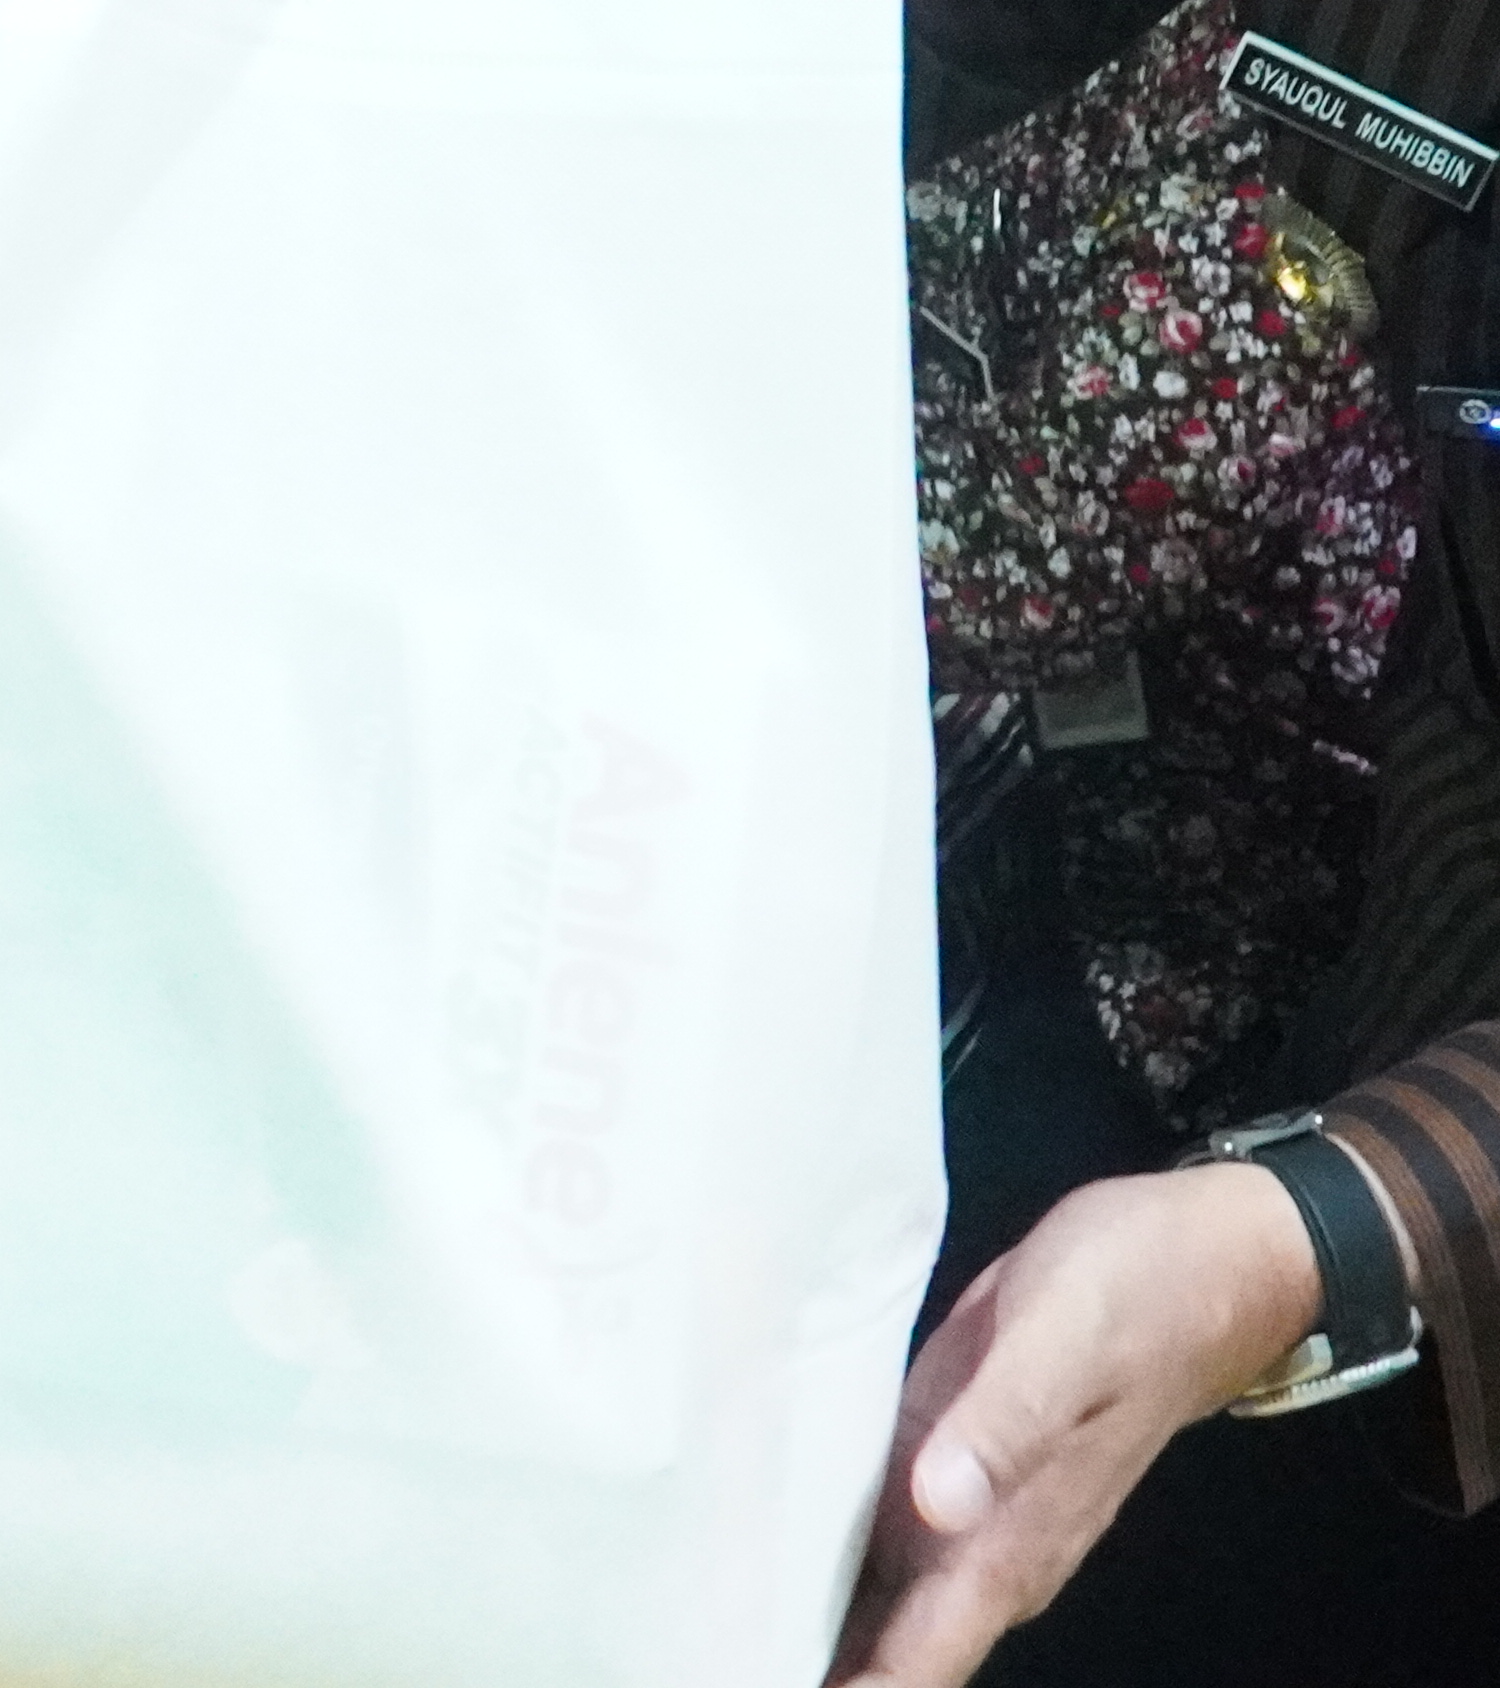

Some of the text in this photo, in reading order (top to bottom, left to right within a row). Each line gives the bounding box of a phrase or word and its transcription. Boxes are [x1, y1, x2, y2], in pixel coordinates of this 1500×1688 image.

[1243, 57, 1477, 189] SYAUQUL MUHIBBIN
[513, 706, 696, 1229] Anlene
